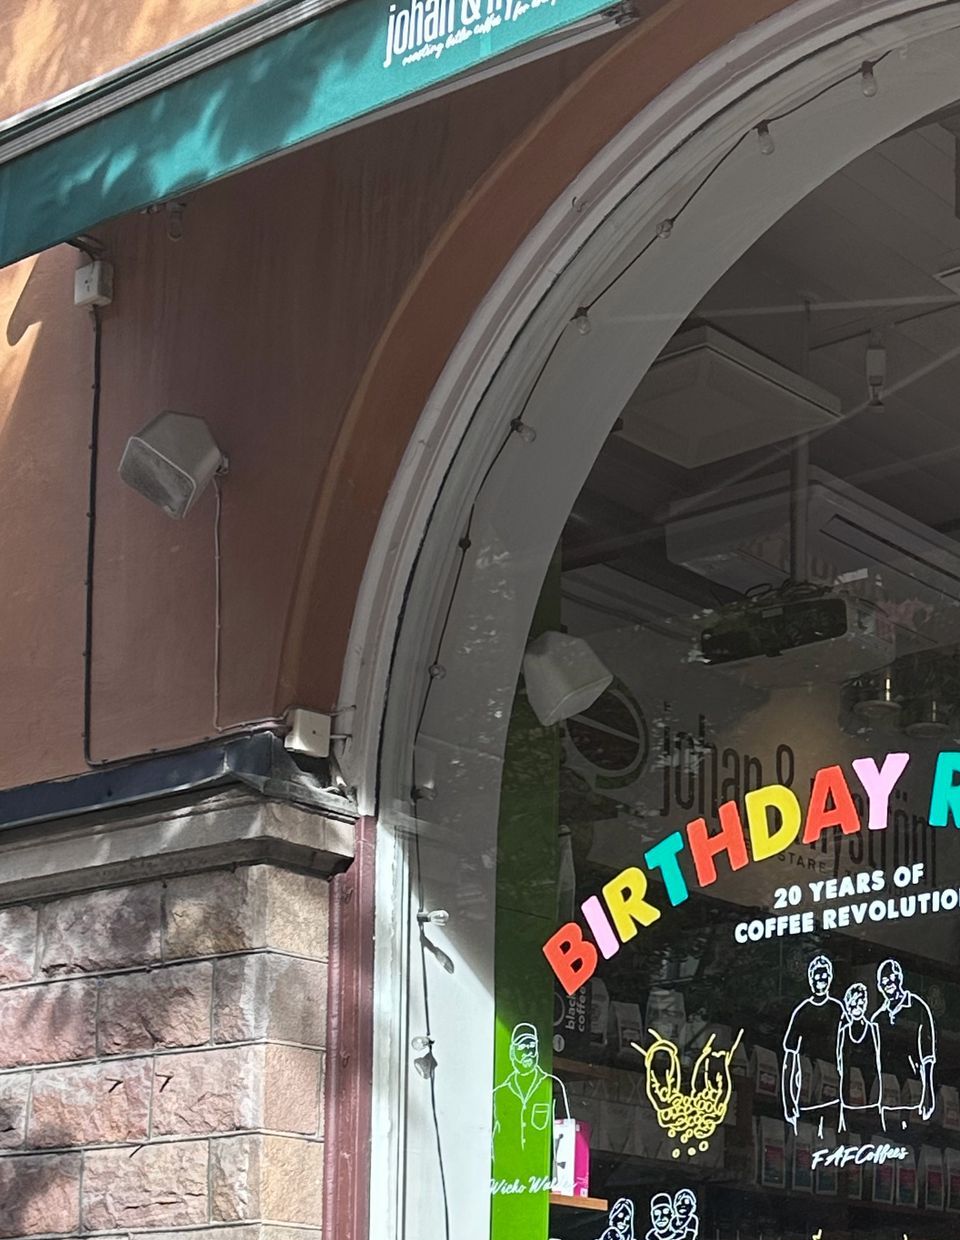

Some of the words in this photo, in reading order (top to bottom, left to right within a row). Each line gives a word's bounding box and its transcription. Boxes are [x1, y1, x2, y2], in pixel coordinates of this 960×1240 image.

[383, 0, 455, 68] johan
[541, 752, 910, 997] BIRTHDAY
[773, 888, 802, 910] 20
[808, 871, 884, 902] YEARS
[894, 863, 925, 888] OF
[734, 911, 814, 943] COFFEE
